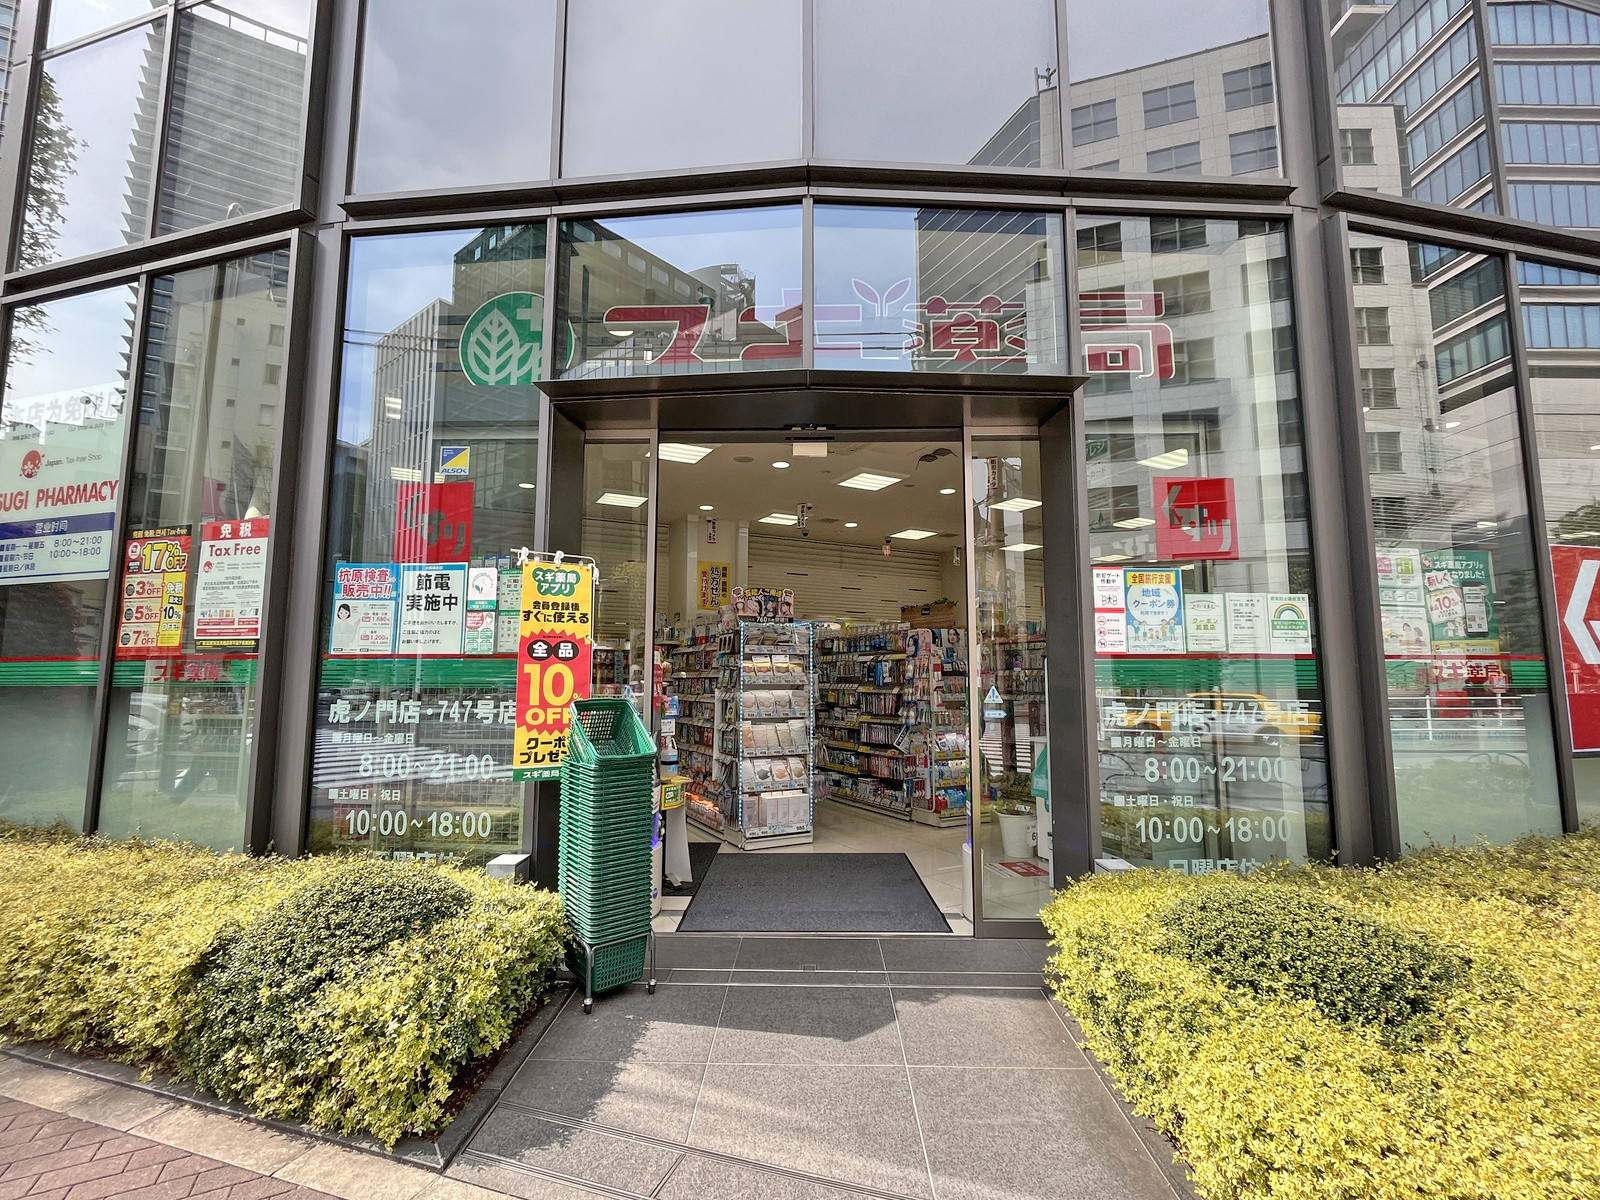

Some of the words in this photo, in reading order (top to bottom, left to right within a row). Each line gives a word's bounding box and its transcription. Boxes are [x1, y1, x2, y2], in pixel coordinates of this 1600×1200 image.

[602, 279, 1174, 380] スギ薬局
[36, 479, 120, 508] PHARMACY
[35, 520, 68, 534] 营业时间
[219, 521, 253, 538] 免税
[209, 544, 230, 557] Tax
[234, 543, 262, 555] Free
[166, 555, 187, 569] OFF
[339, 568, 390, 582] 抗原検査
[416, 573, 451, 591] 節電
[535, 571, 577, 583] スギ薬局
[1131, 573, 1172, 584] 全国旅行支援
[540, 583, 571, 593] アプリ
[1142, 588, 1162, 598] 地域
[406, 594, 459, 612] 実施中
[532, 600, 580, 611] 会員登録後
[1133, 599, 1176, 608] クーポン券
[522, 610, 589, 624] すぐに使える
[532, 641, 574, 658] 全品
[328, 699, 516, 724] 虎ノ門店・747号店
[1104, 700, 1310, 727] 虎ノ門店・747号店
[526, 735, 569, 750] クーポ
[522, 770, 560, 779] スギ薬局
